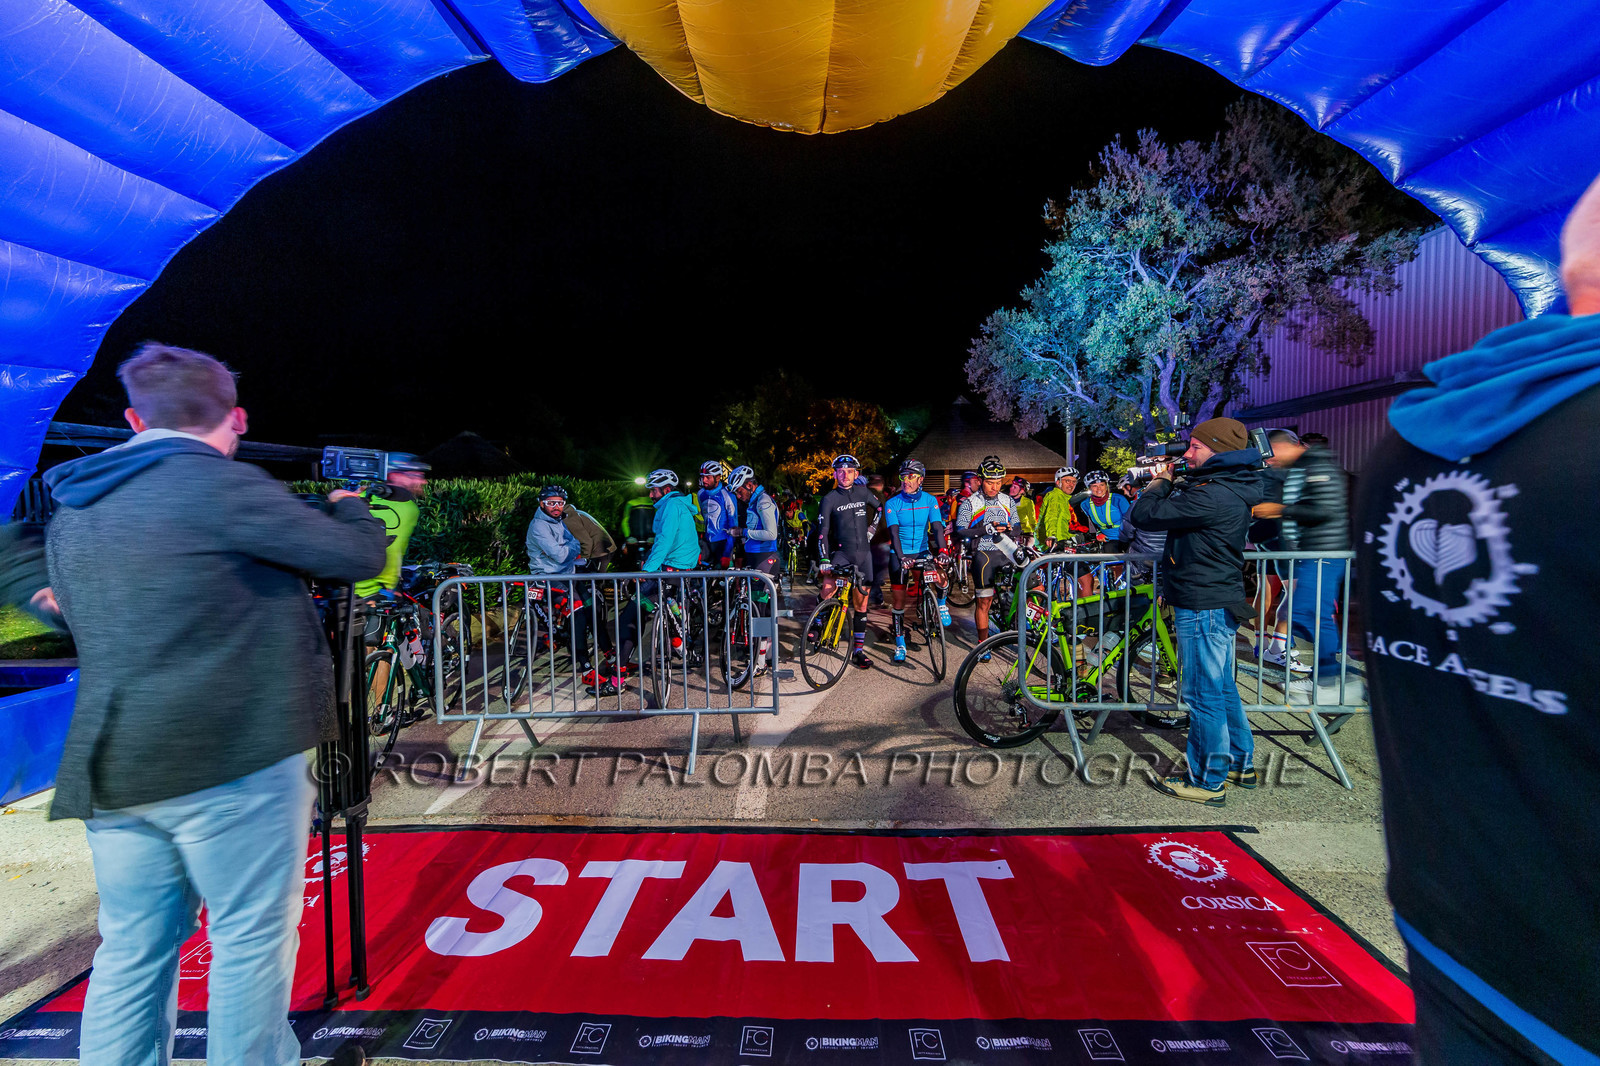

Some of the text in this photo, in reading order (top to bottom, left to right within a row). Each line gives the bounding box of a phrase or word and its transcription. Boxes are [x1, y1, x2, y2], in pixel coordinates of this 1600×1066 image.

[924, 575, 933, 583] 46
[424, 857, 1015, 963] START
[1181, 895, 1286, 912] CORSICA
[1259, 947, 1311, 971] FC
[415, 1022, 444, 1039] FC
[490, 1027, 547, 1039] BIKINGMAN
[579, 1027, 605, 1043] FC
[746, 1029, 769, 1046] FC
[655, 1034, 711, 1045] BIKINGMAN
[822, 1036, 879, 1046] BIKINGMAN
[914, 1032, 938, 1049] FC
[992, 1036, 1052, 1047] BIKINGMAN
[1084, 1032, 1113, 1049] FC
[1167, 1039, 1230, 1049] BIKINGMAN
[1260, 1031, 1292, 1047] FC
